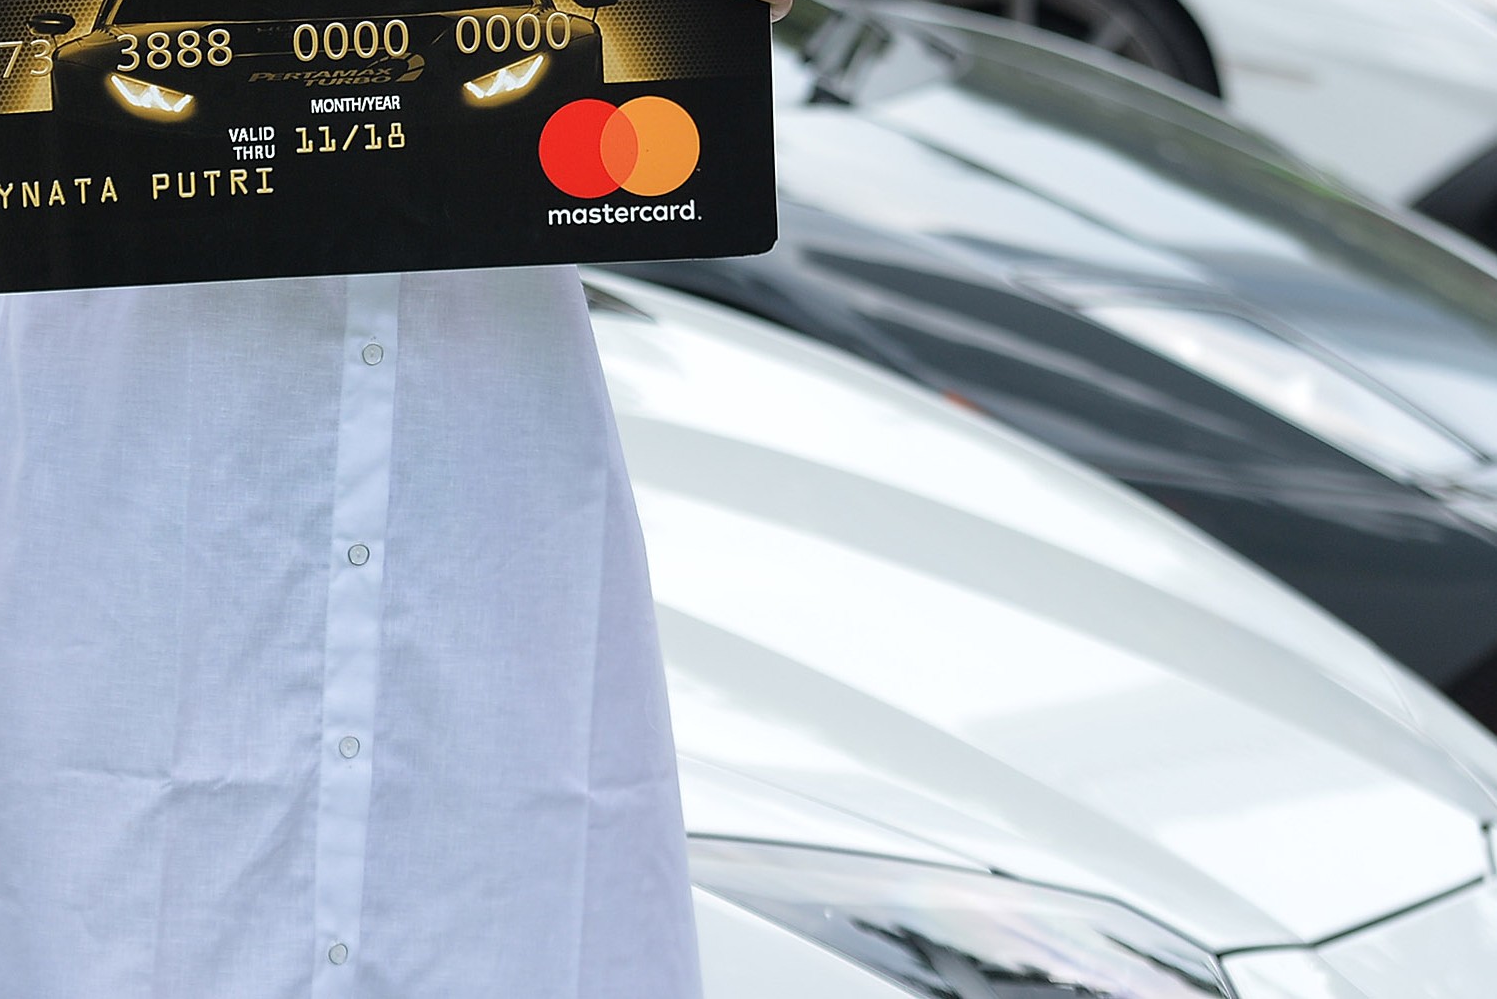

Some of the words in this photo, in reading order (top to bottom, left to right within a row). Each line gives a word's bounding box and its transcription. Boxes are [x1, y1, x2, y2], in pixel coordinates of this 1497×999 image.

[116, 28, 233, 72] 3888
[293, 19, 409, 62] 0000
[456, 12, 571, 54] 0000
[248, 67, 392, 82] PERTAMAX
[303, 76, 392, 87] TURBO
[311, 95, 401, 114] MONTH/YEAR
[229, 126, 275, 143] VALID
[295, 122, 406, 153] 11/18
[233, 145, 276, 160] THRU
[152, 167, 274, 201] PUTRI
